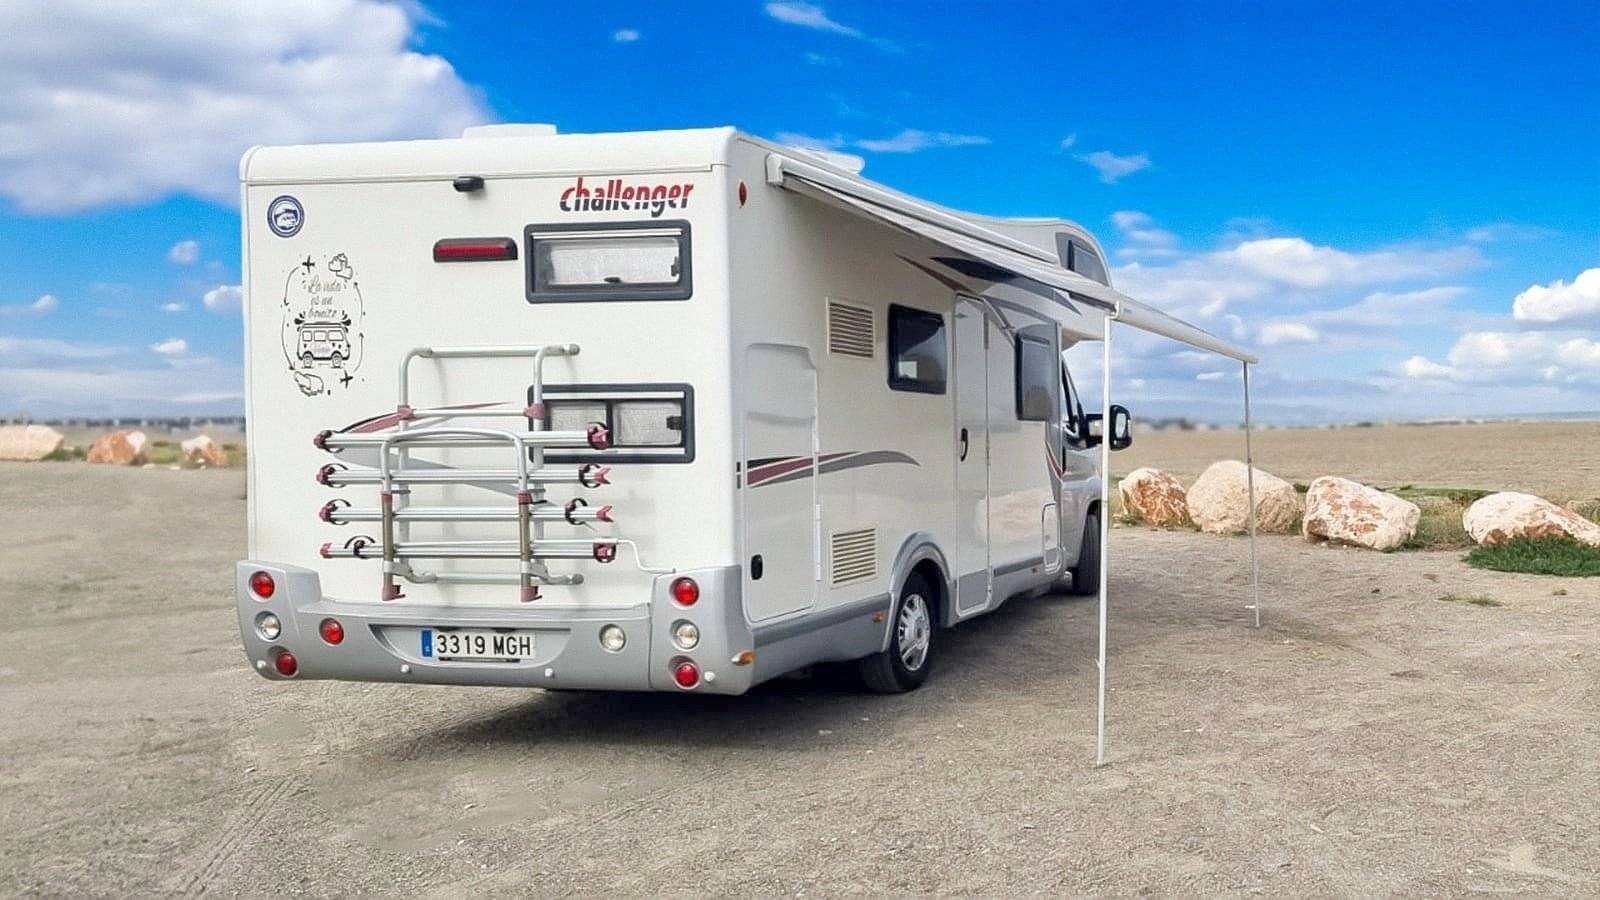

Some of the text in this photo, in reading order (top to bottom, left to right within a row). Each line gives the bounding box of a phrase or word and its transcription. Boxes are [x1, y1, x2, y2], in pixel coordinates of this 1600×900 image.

[560, 177, 694, 218] challenger
[437, 635, 485, 654] 3319
[493, 636, 530, 655] MGH
